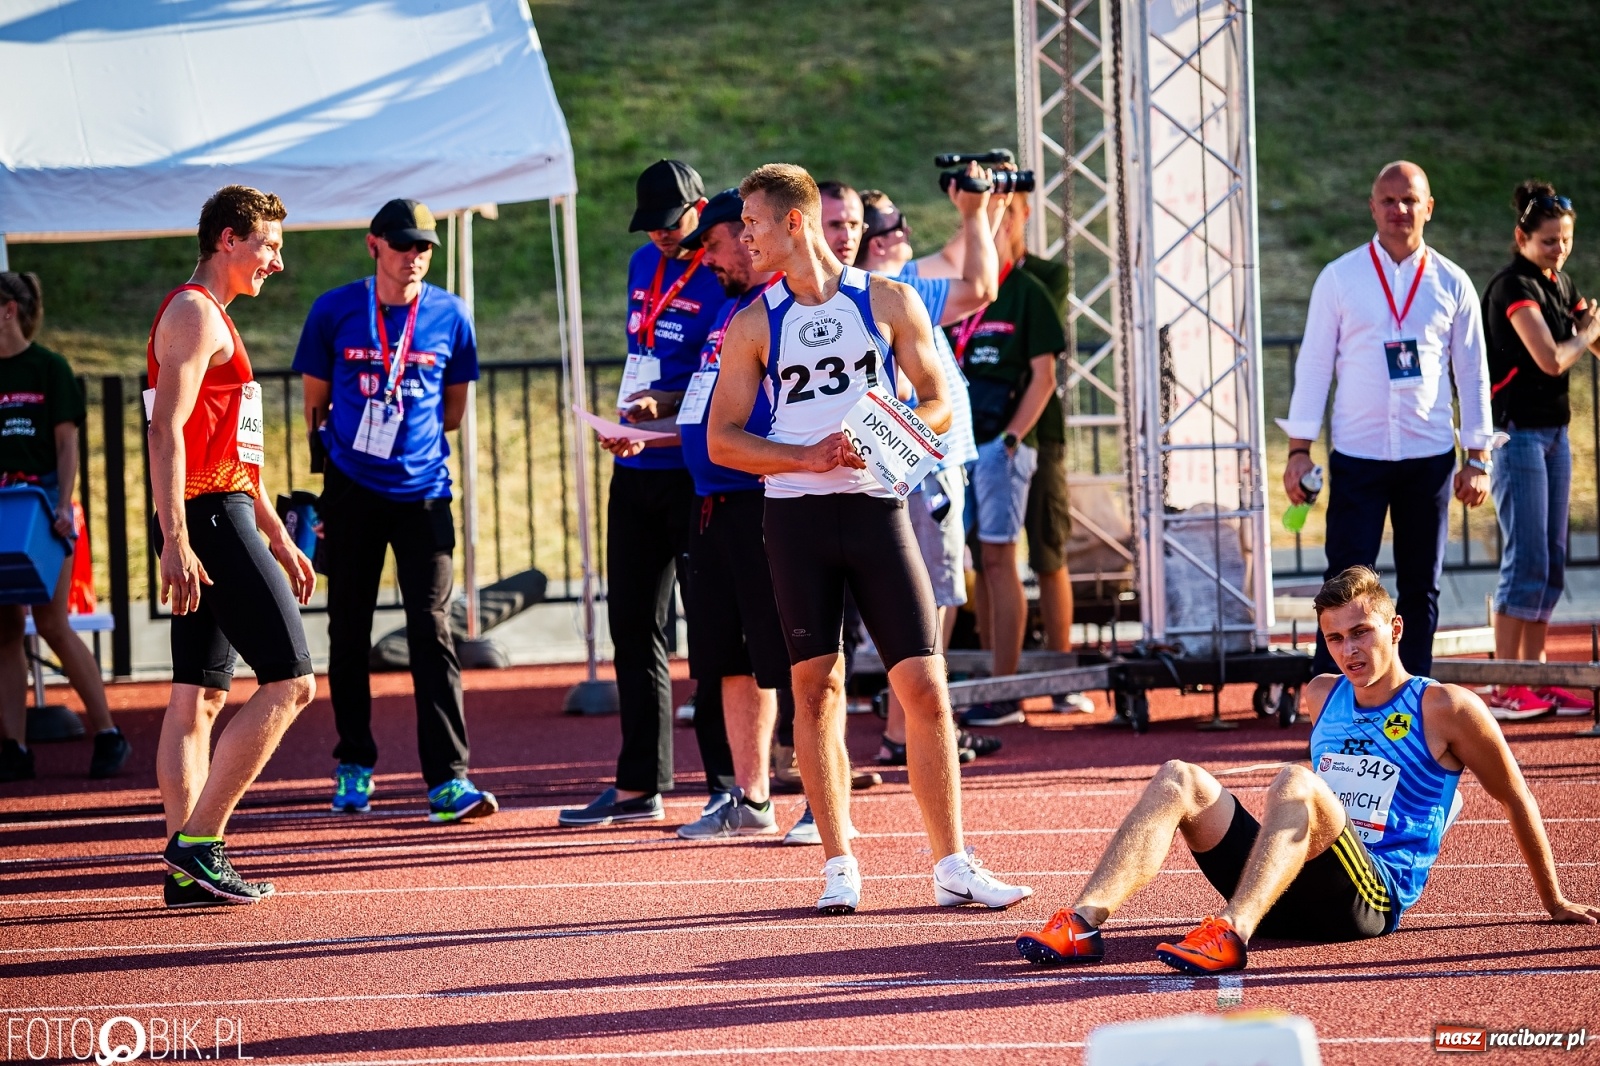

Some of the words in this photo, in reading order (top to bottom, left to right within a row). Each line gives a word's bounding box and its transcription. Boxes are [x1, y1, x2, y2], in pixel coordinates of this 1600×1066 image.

[820, 317, 837, 325] LUKS
[780, 349, 879, 405] 231
[882, 394, 903, 411] 2019
[902, 408, 942, 448] RACIBÓRZ
[862, 412, 921, 468] BILIŃSKI
[1356, 758, 1396, 781] 349
[1332, 791, 1382, 811] BRYCH
